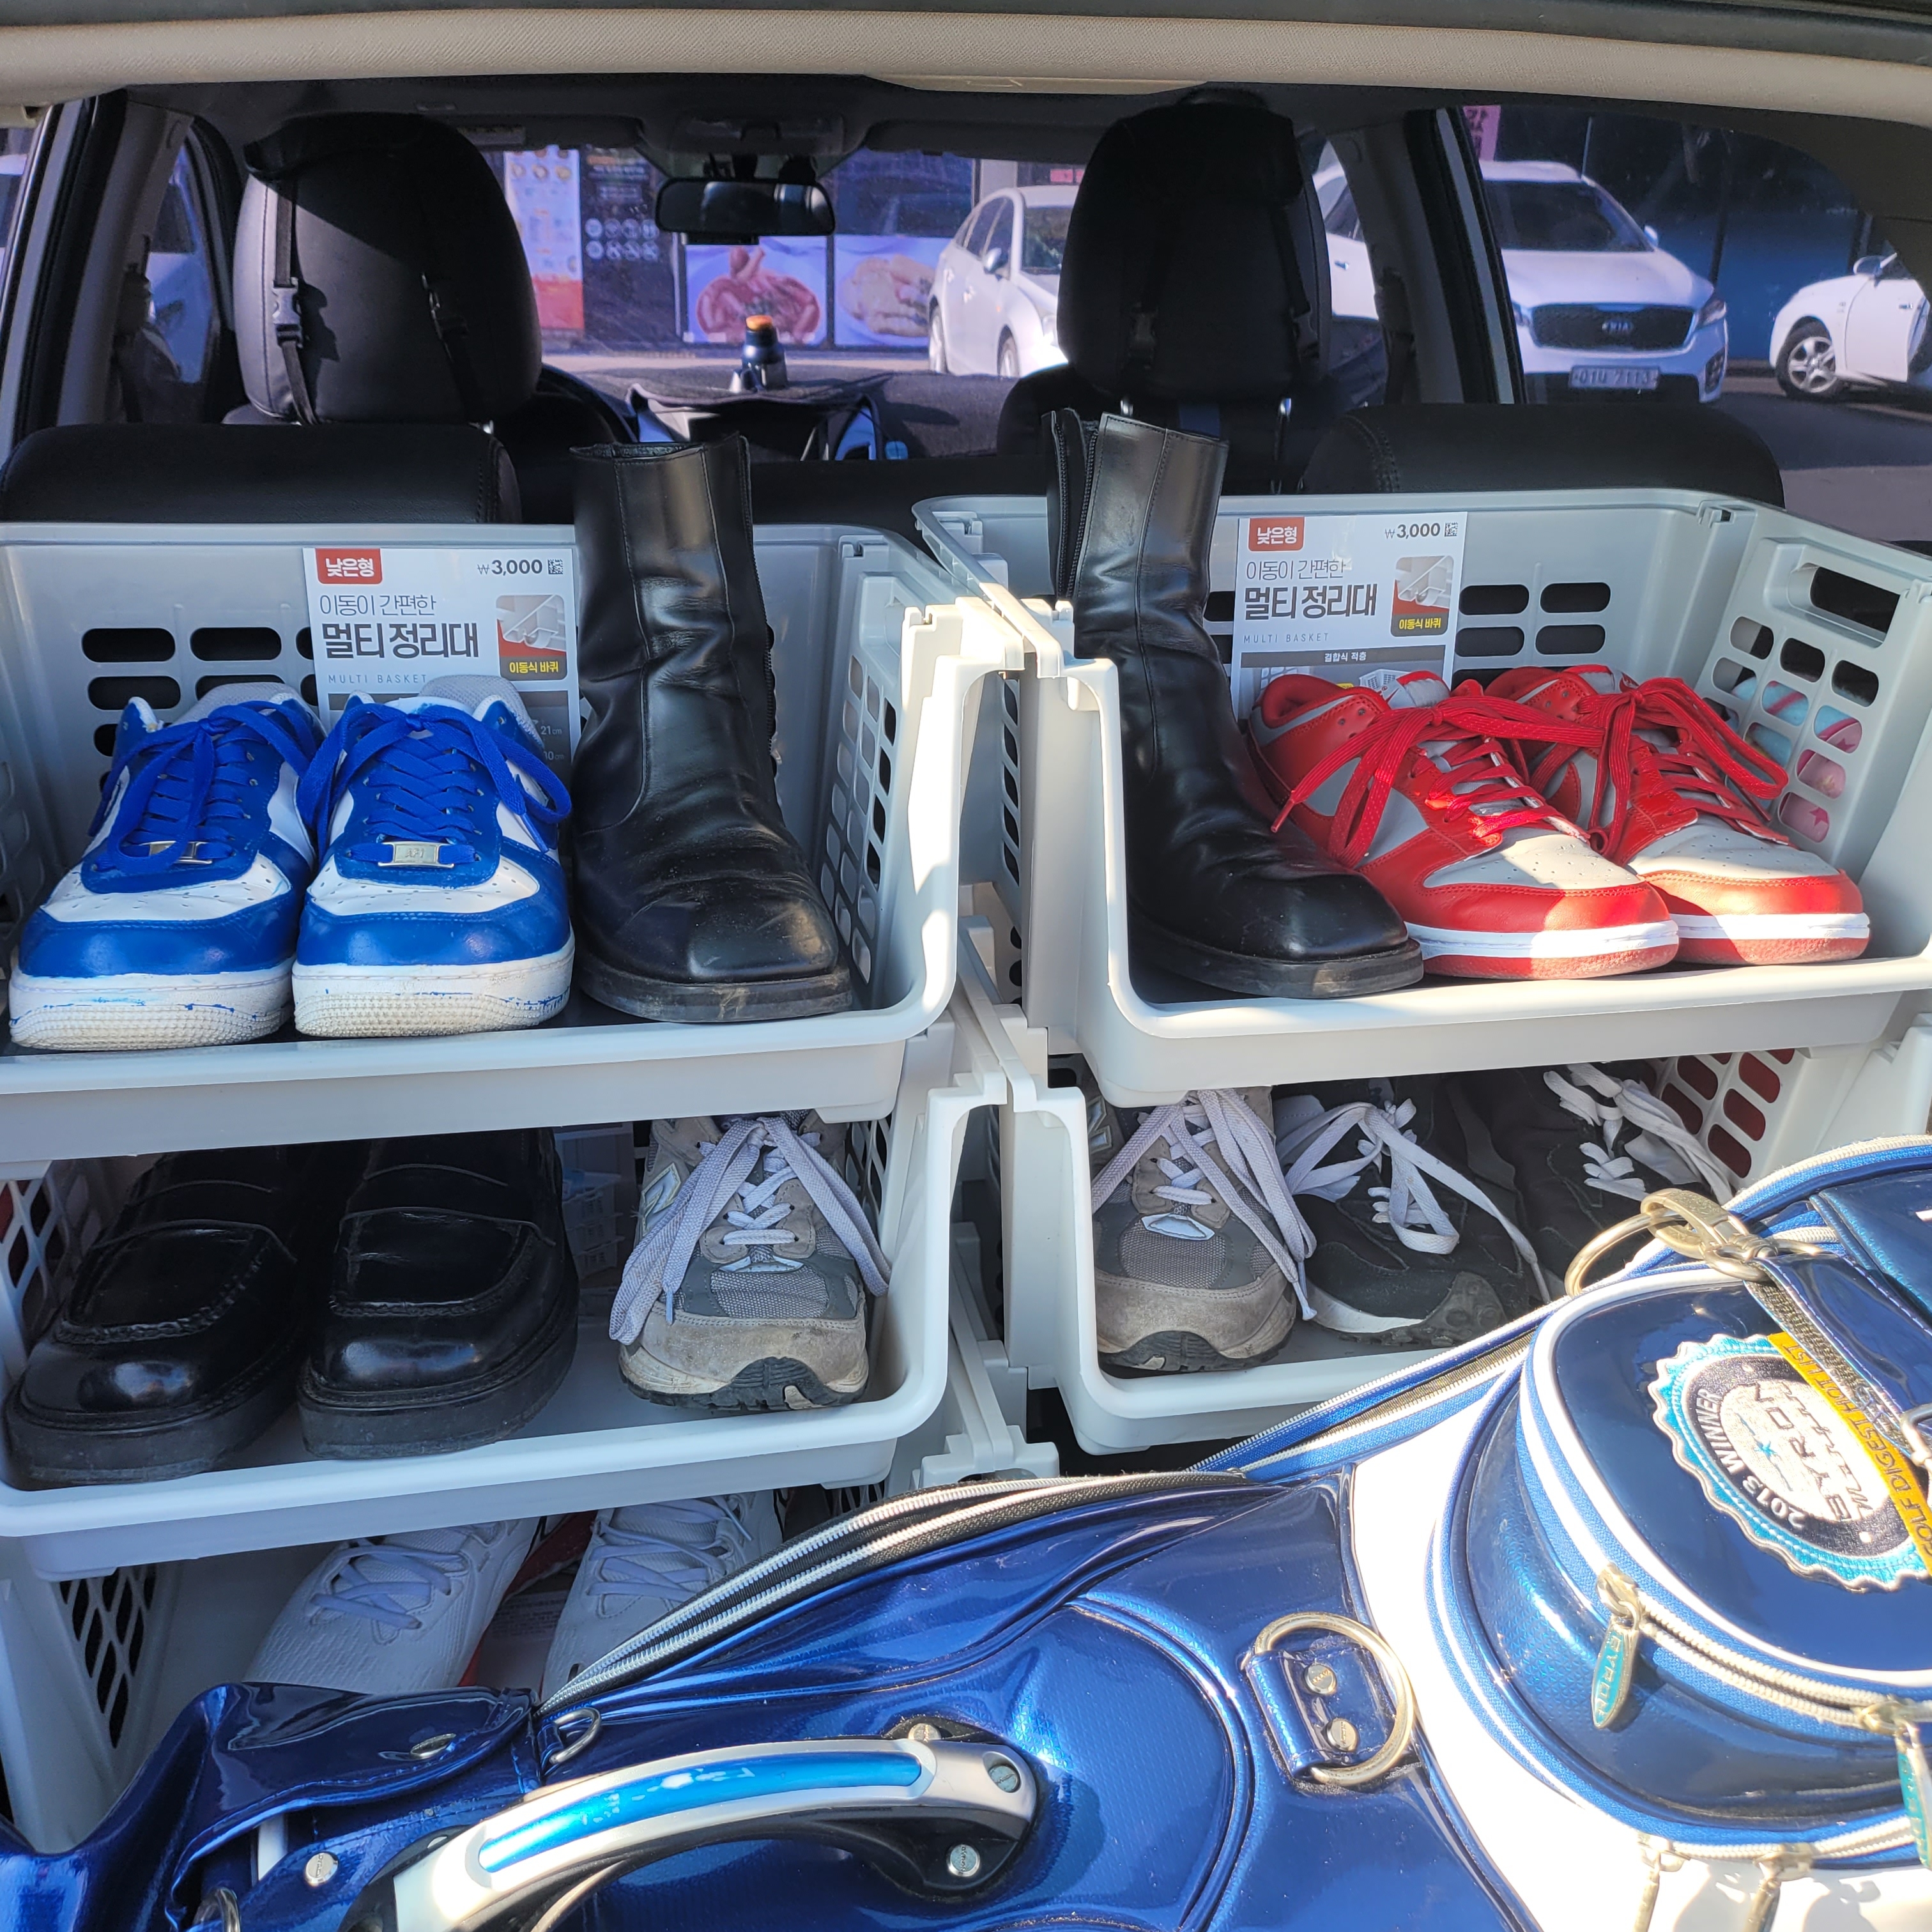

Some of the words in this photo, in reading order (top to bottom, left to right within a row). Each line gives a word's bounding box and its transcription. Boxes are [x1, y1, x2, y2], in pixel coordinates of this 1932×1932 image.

[1257, 526, 1298, 545] 낮은형
[325, 558, 374, 578] 낮은형
[1246, 560, 1294, 581] 이동이
[1297, 559, 1346, 580] 간편한
[319, 594, 376, 616] 이동이
[379, 594, 436, 617] 간편한
[1399, 618, 1423, 631] 이동식
[1425, 618, 1441, 629] 바퀴
[1243, 634, 1278, 644] MULTI
[1286, 632, 1329, 643] BASKET
[509, 662, 537, 674] 이동식
[540, 661, 560, 673] 바퀴
[1324, 652, 1348, 663] 결합식
[1351, 652, 1367, 661] 적층
[328, 674, 368, 684] MULTI
[377, 674, 427, 684] BASKET
[1782, 1344, 1824, 1375] LIST
[1814, 1377, 1857, 1413] HOT
[1696, 1388, 1745, 1475] WINNER
[1738, 1382, 1852, 1520] BYRON
[1848, 1418, 1912, 1491] DIGEST
[1742, 1475, 1807, 1529] 2013
[1597, 1634, 1621, 1716] BYRON
